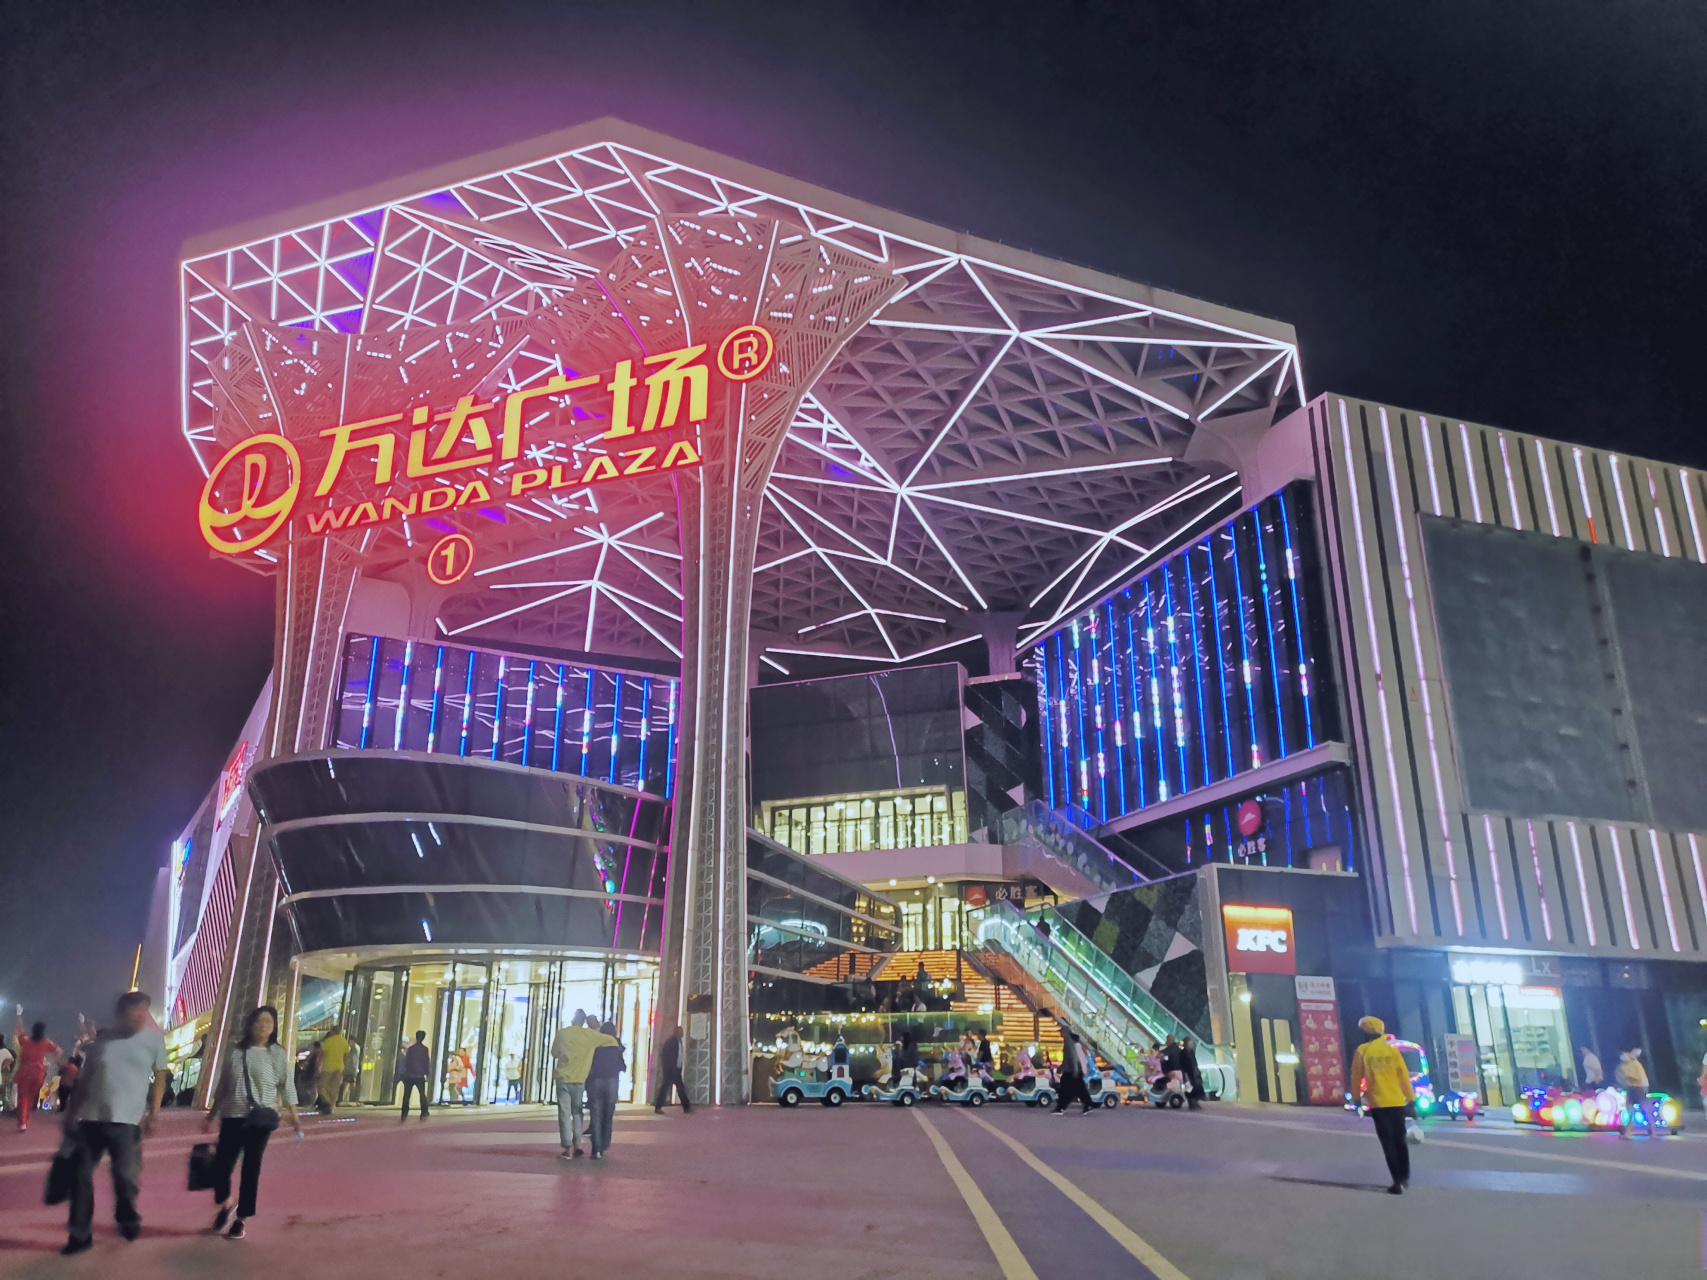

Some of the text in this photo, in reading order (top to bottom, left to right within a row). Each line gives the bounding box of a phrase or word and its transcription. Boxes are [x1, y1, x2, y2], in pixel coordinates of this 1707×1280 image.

[314, 344, 708, 497] 万达广场
[307, 440, 704, 532] WANDA PLAZA
[1236, 928, 1288, 953] KFC
